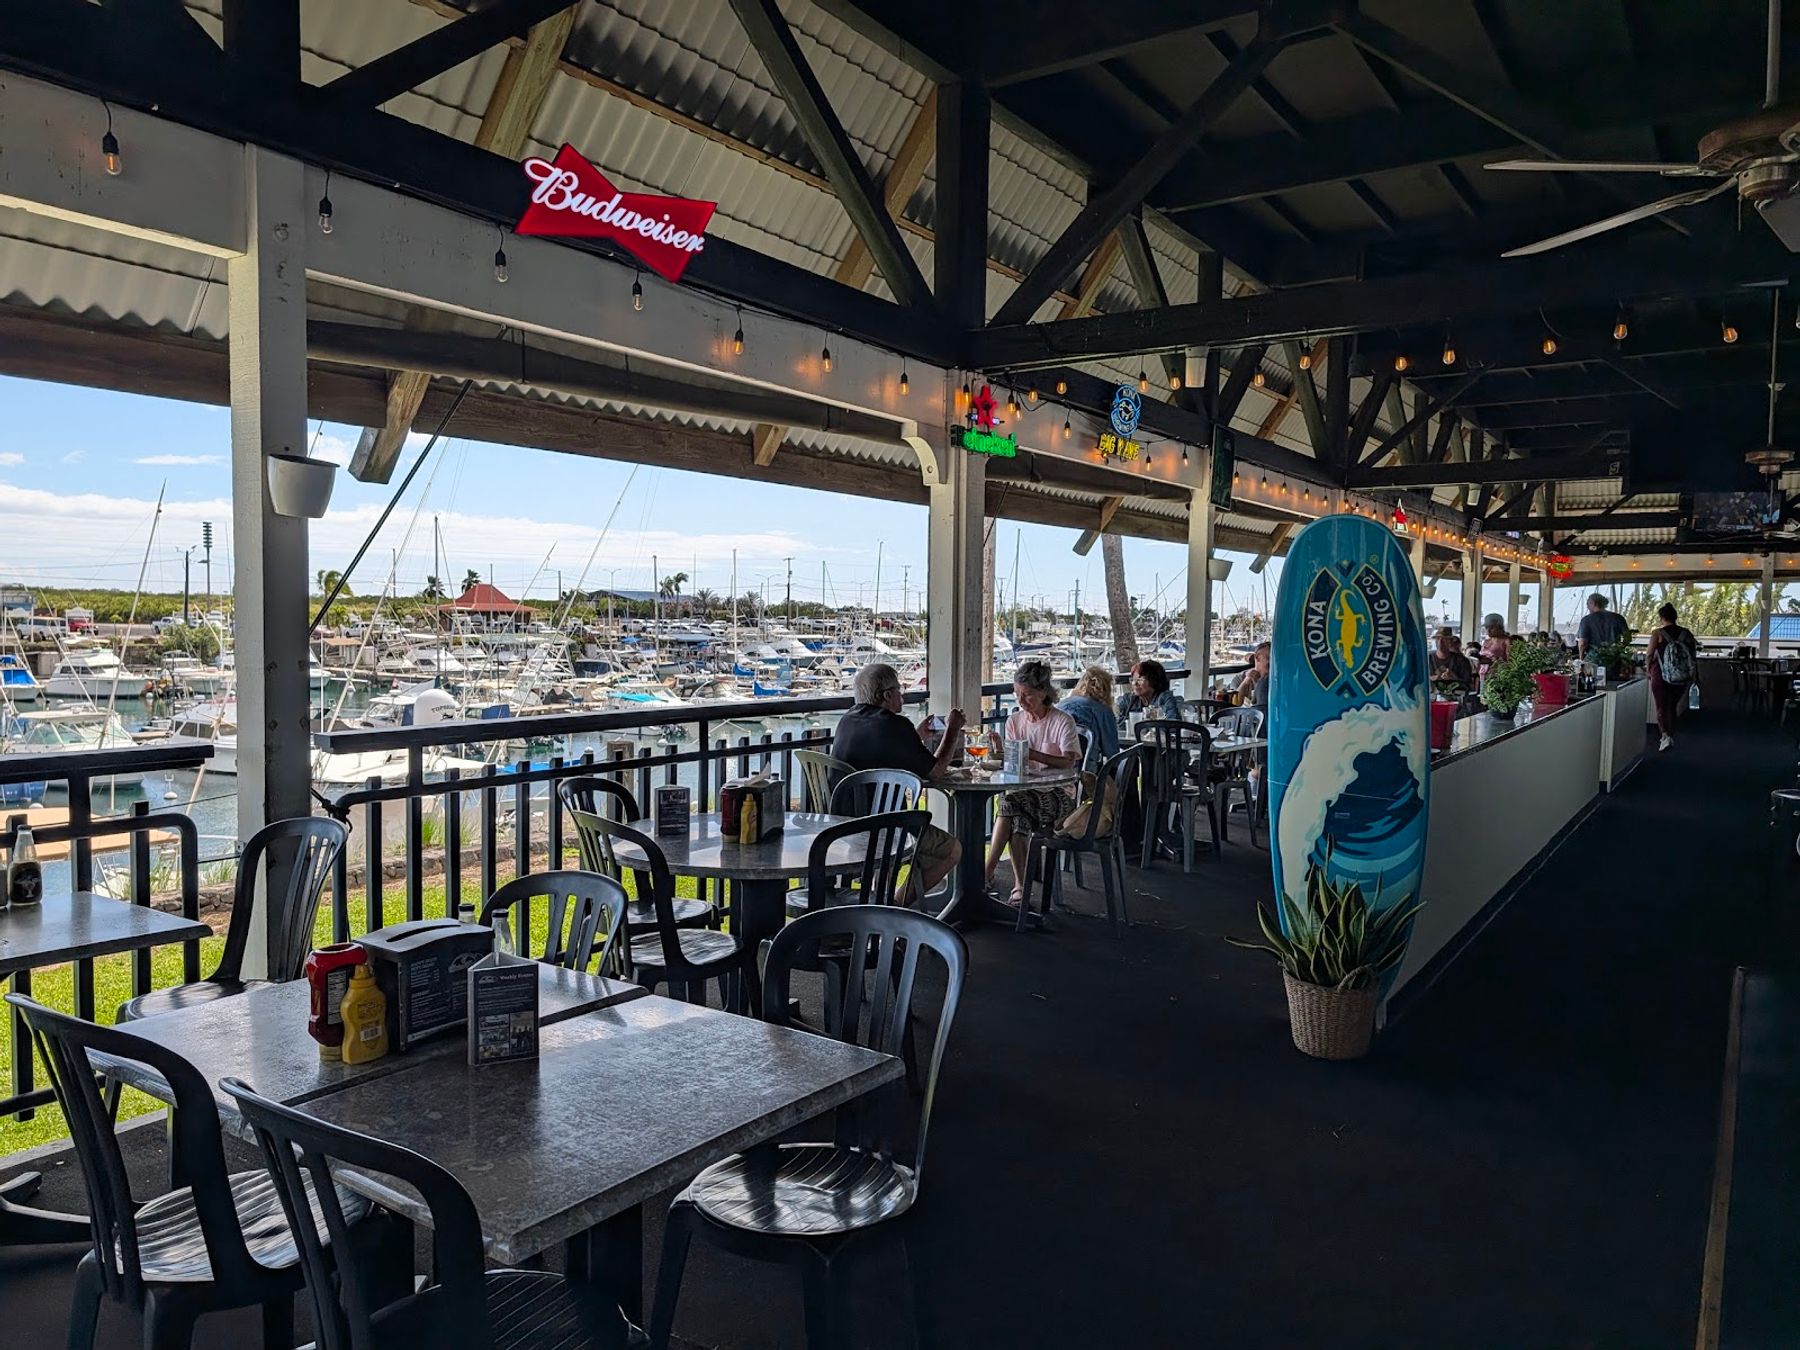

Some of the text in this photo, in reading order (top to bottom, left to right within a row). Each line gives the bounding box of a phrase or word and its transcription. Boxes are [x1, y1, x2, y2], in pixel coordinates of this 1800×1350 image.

[524, 158, 705, 252] Budweiser
[1307, 600, 1328, 660] KONA
[1361, 599, 1394, 685] BREWING
